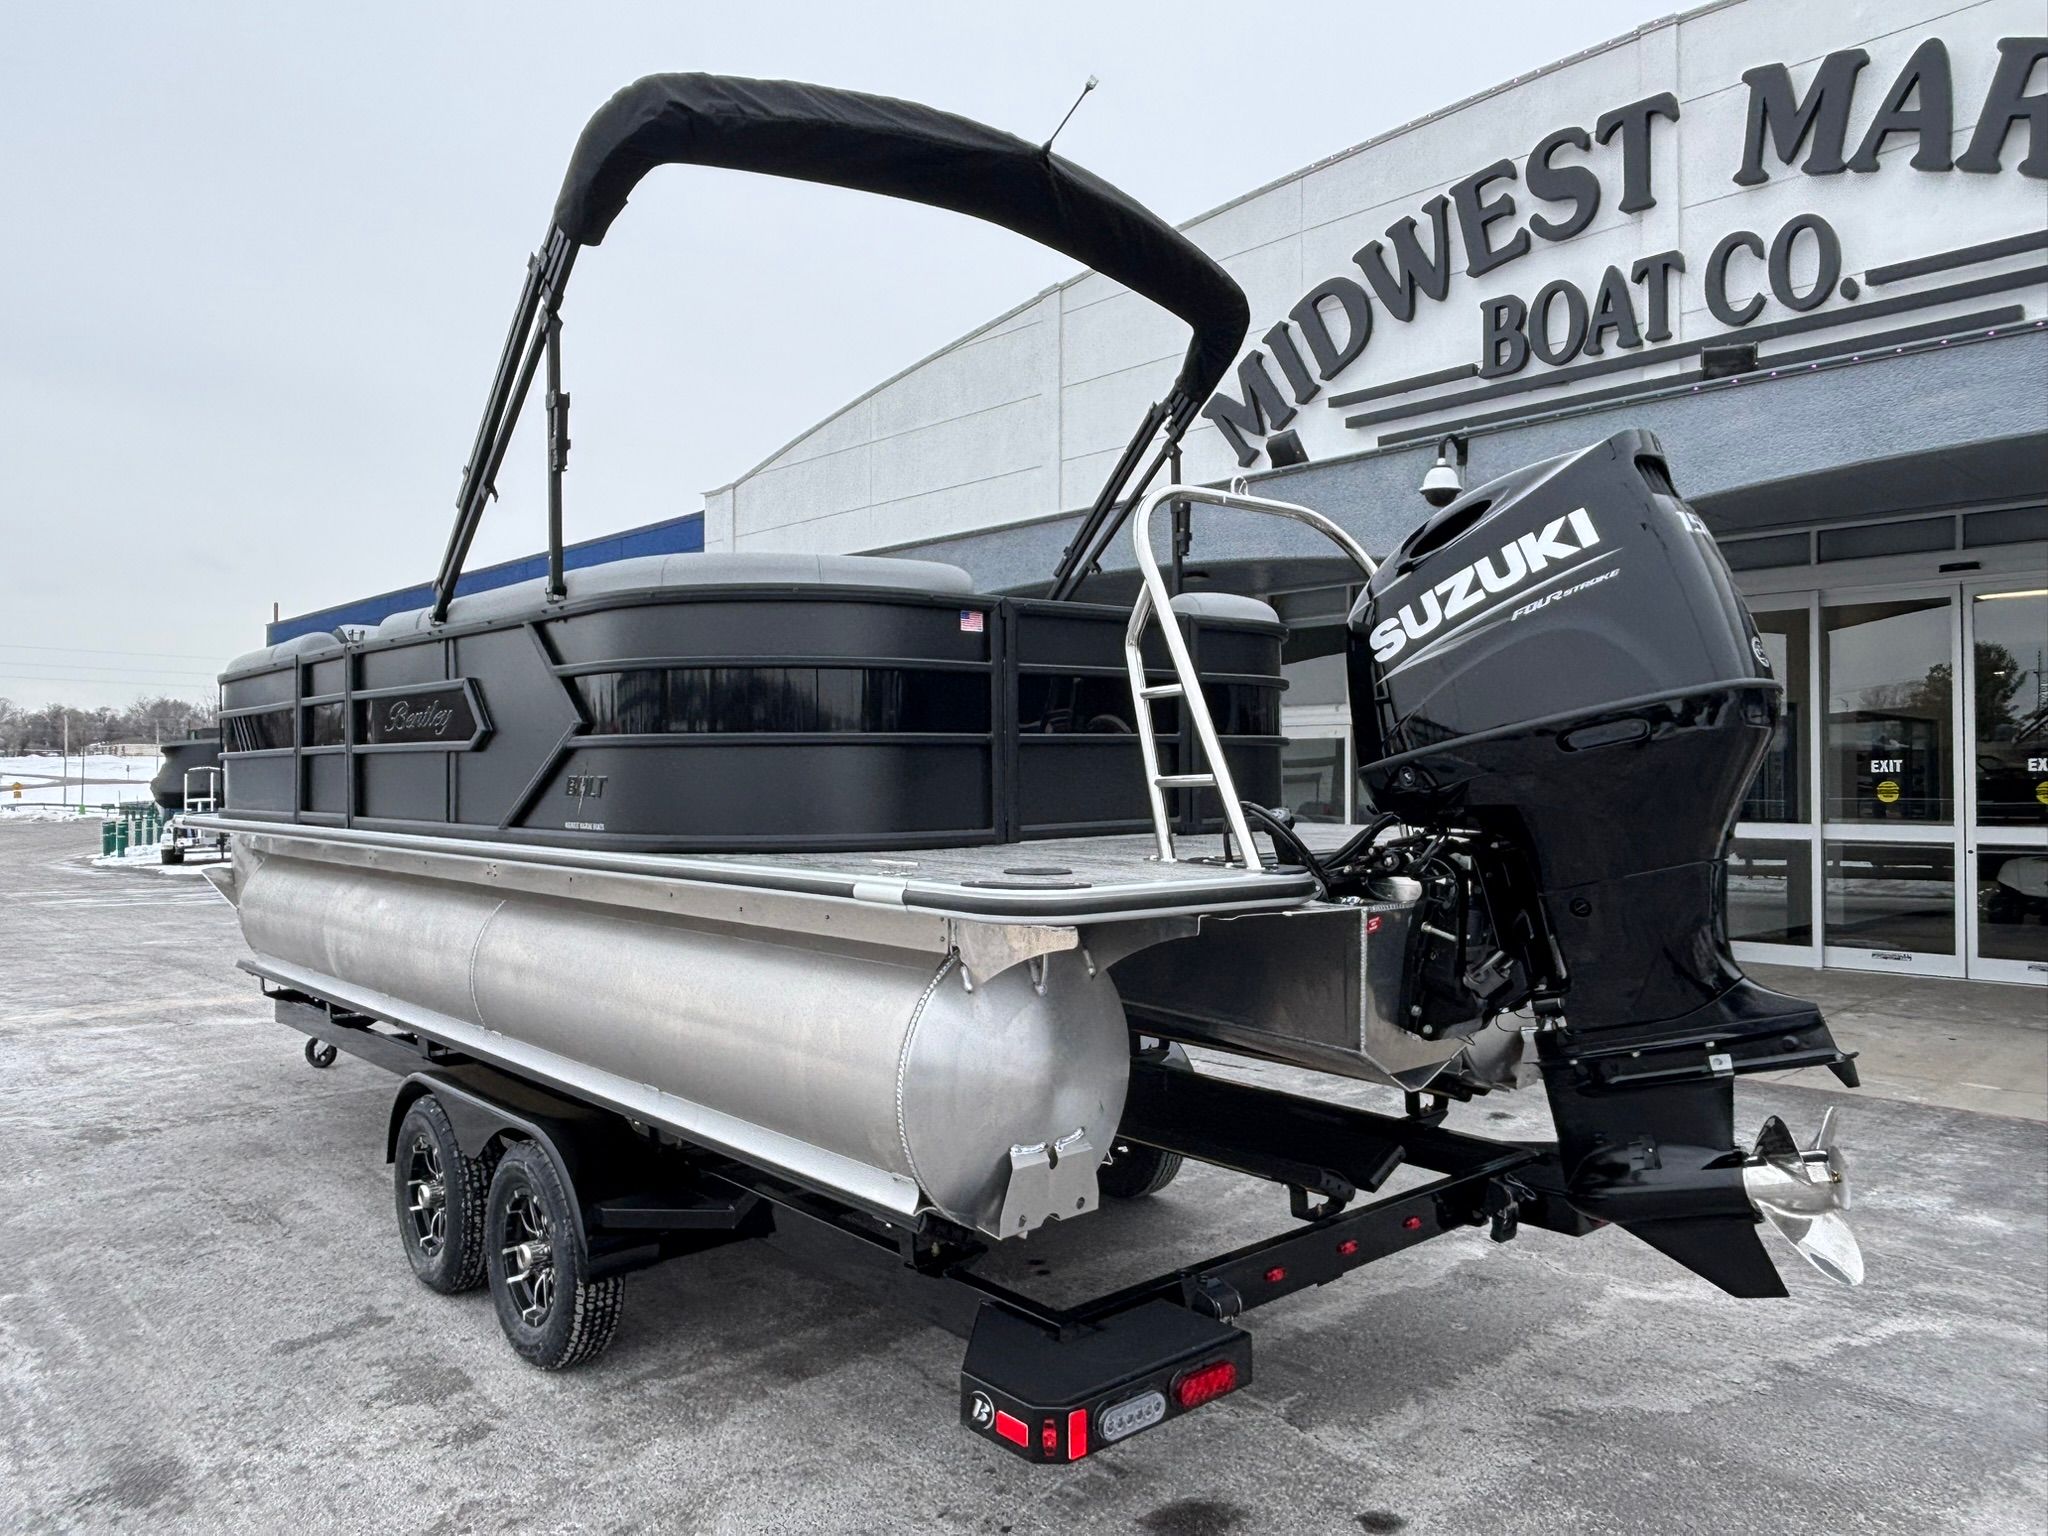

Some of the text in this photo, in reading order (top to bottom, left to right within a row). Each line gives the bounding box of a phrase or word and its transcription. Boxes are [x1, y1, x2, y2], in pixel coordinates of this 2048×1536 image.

[1201, 91, 1680, 468] MIDWEST
[1478, 213, 1860, 380] BOAT CO.
[1369, 507, 1600, 664] SUZUKI
[384, 699, 453, 736] Bentley
[1870, 759, 1903, 773] EXIT
